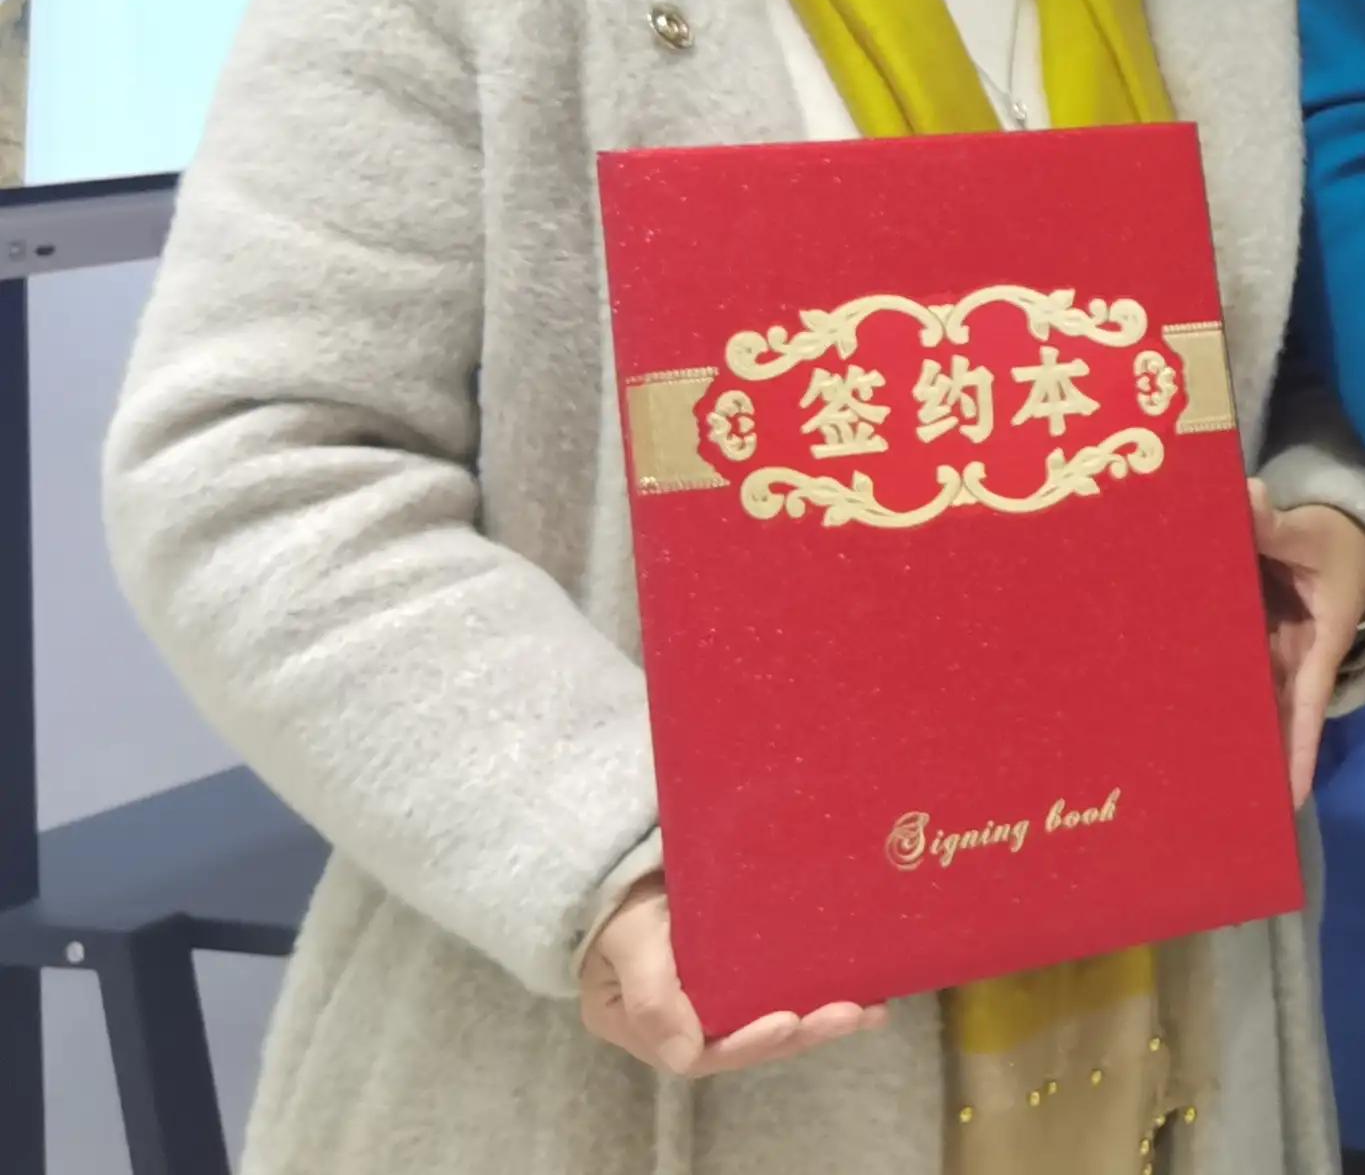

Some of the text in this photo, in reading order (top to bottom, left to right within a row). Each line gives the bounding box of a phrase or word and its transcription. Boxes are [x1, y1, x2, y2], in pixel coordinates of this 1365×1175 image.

[800, 346, 1100, 459] 签约本
[885, 786, 1121, 871] Signing book
